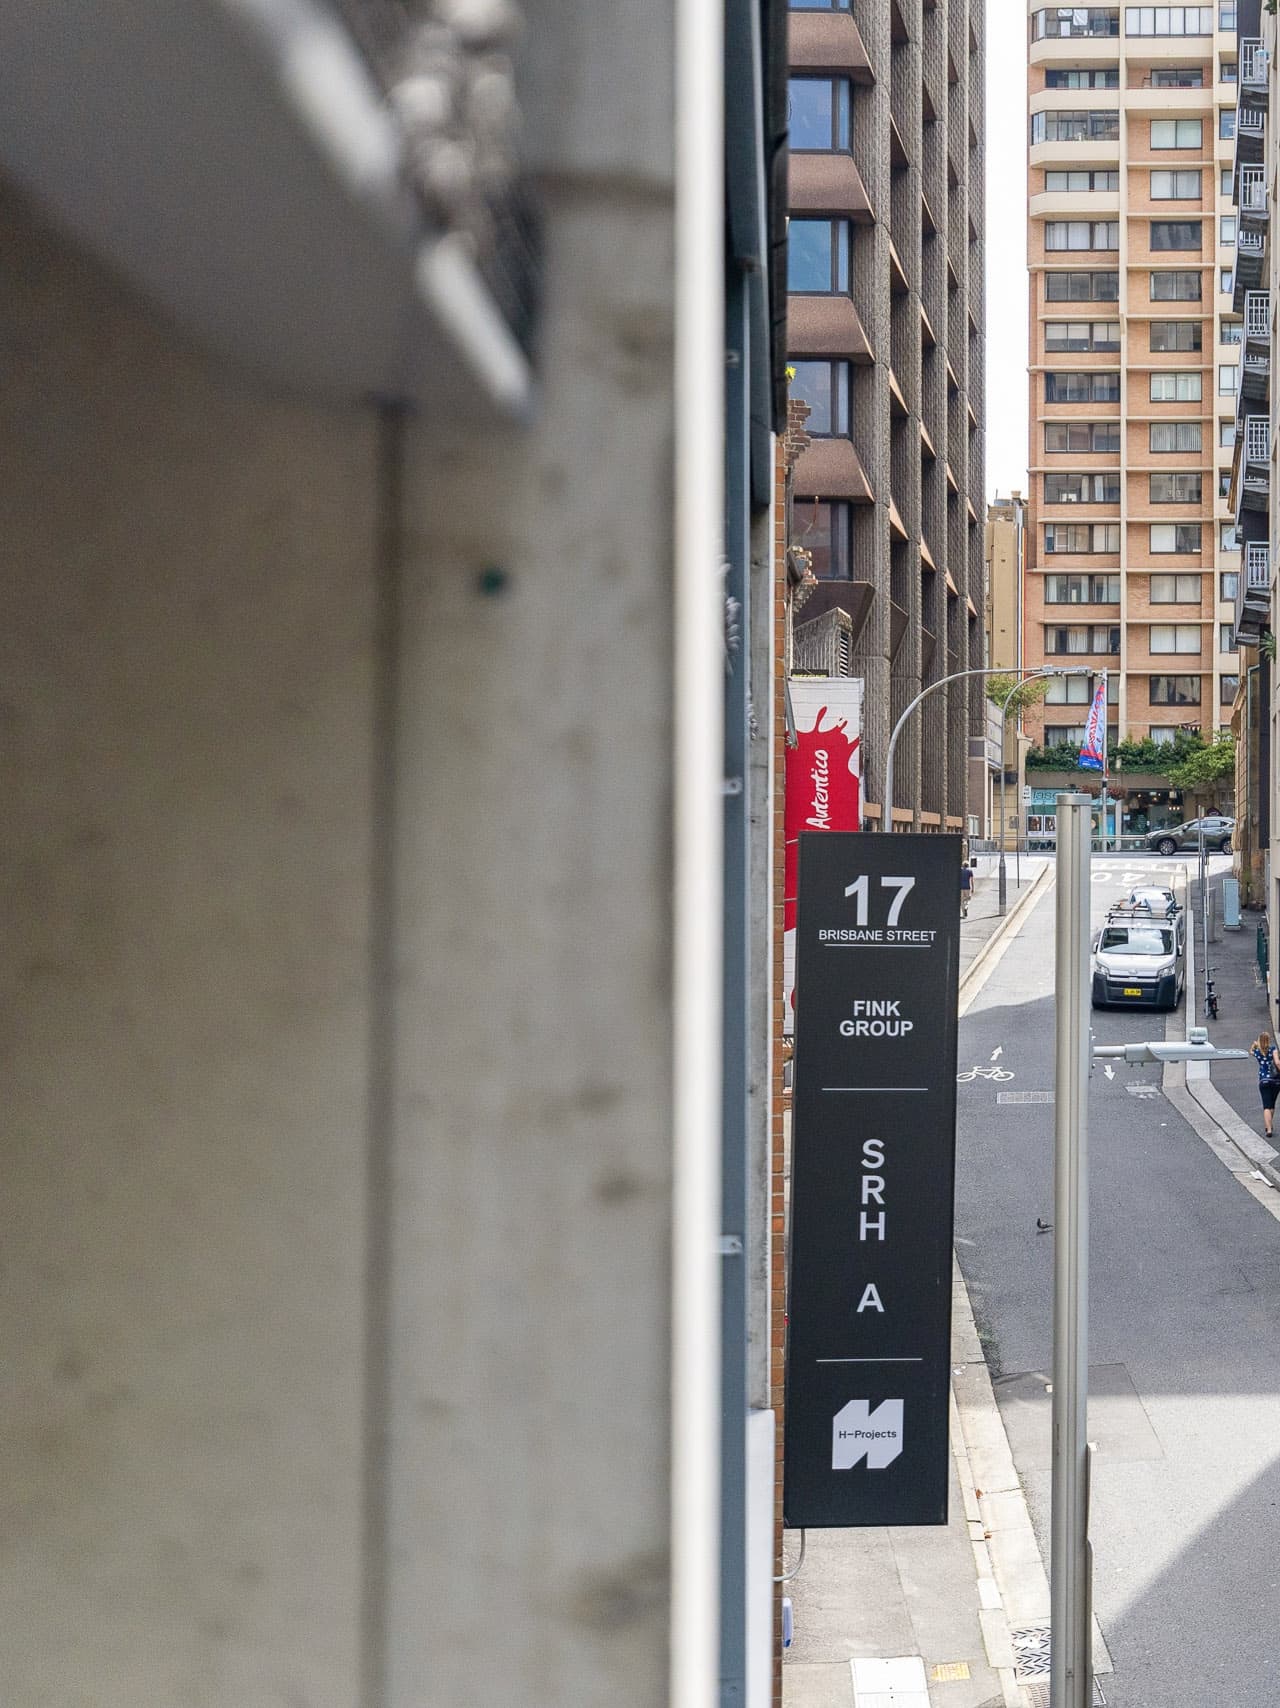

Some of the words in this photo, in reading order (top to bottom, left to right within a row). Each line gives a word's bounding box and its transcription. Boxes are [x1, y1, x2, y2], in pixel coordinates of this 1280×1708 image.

[806, 749, 831, 829] Autentico
[844, 874, 916, 927] 17
[818, 929, 883, 942] BRISBANE
[886, 929, 937, 942] STREET
[853, 999, 901, 1017] FINK
[839, 1019, 914, 1037] GROUP
